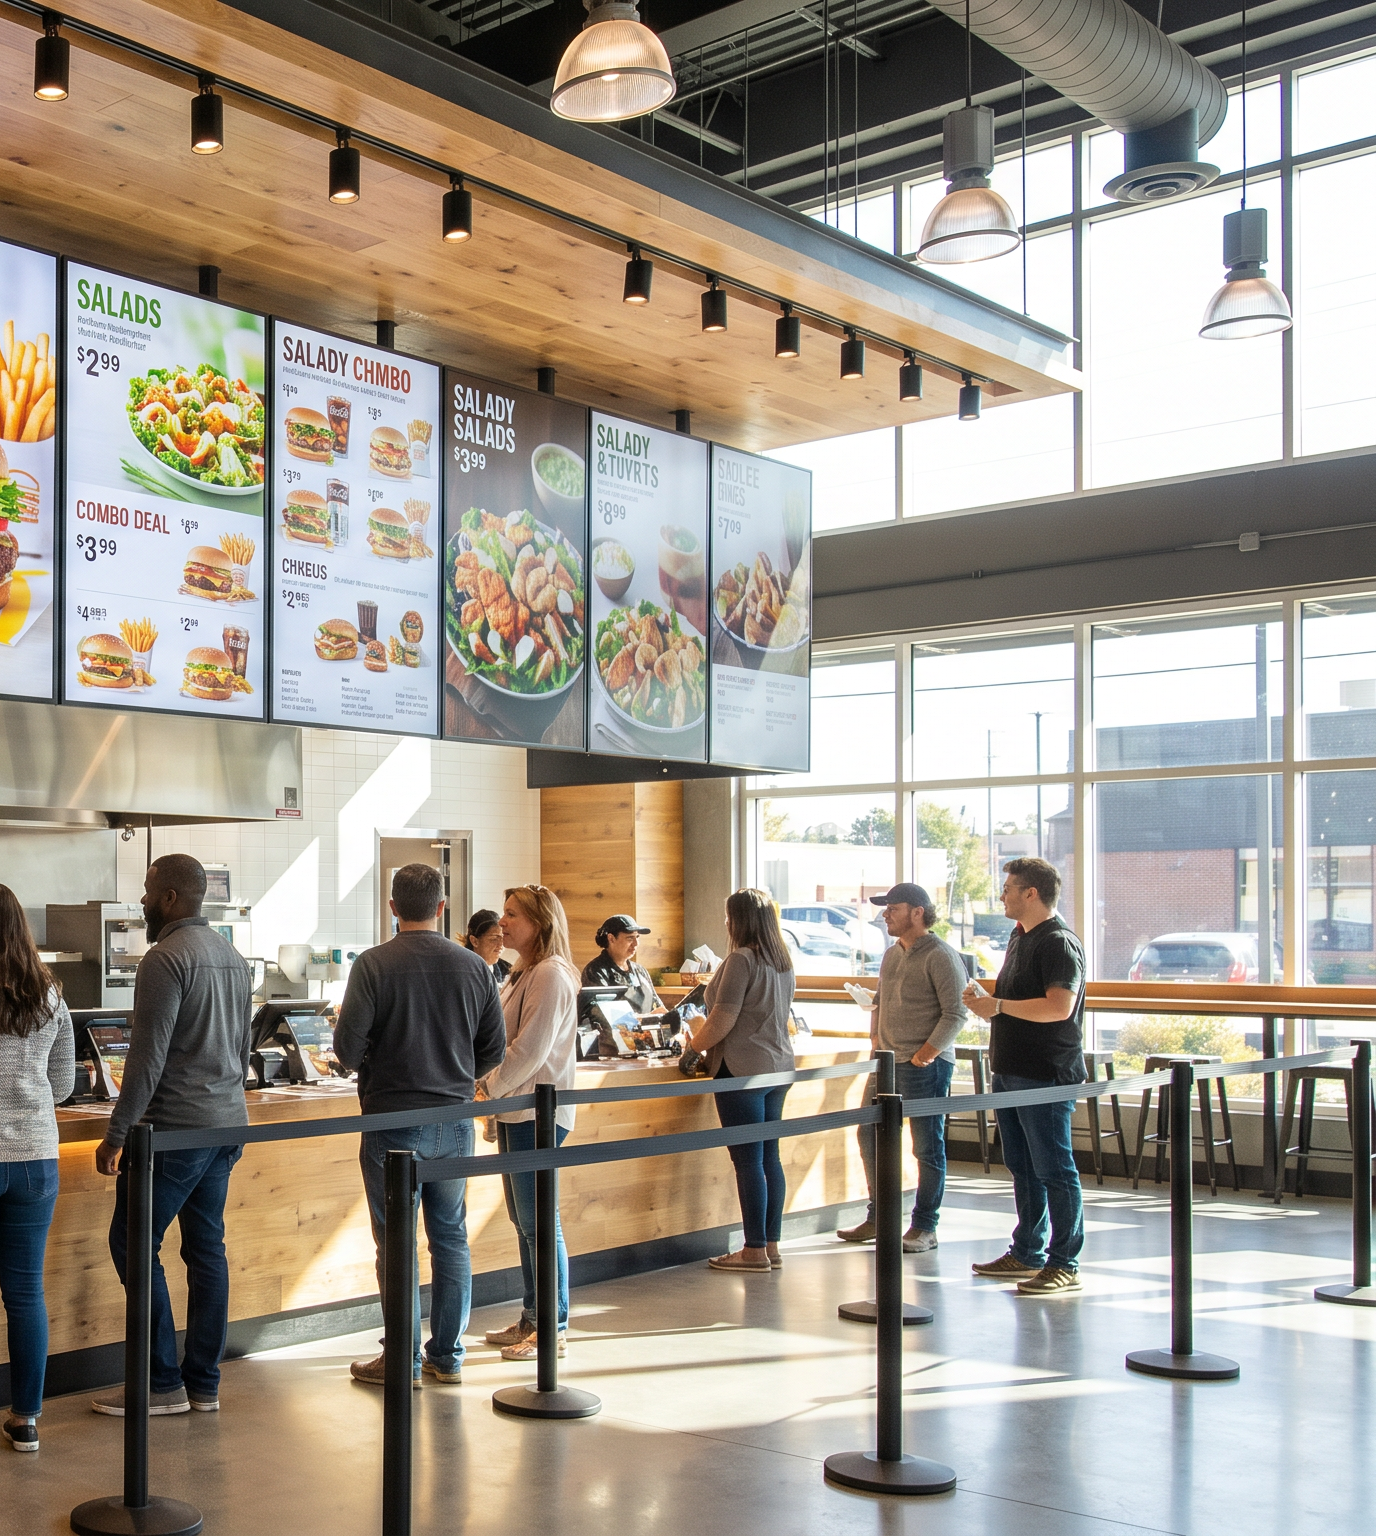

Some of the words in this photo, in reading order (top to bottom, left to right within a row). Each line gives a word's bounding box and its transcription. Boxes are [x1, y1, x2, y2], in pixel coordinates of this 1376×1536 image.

[77, 278, 162, 328] SALADS
[283, 336, 349, 377] SALADY
[353, 356, 411, 394] CHMBO
[453, 383, 516, 425] SALADY
[453, 412, 516, 454] SALADS
[596, 423, 651, 460] SALADY
[76, 499, 130, 527] COMBO
[134, 509, 170, 534] DEAL
